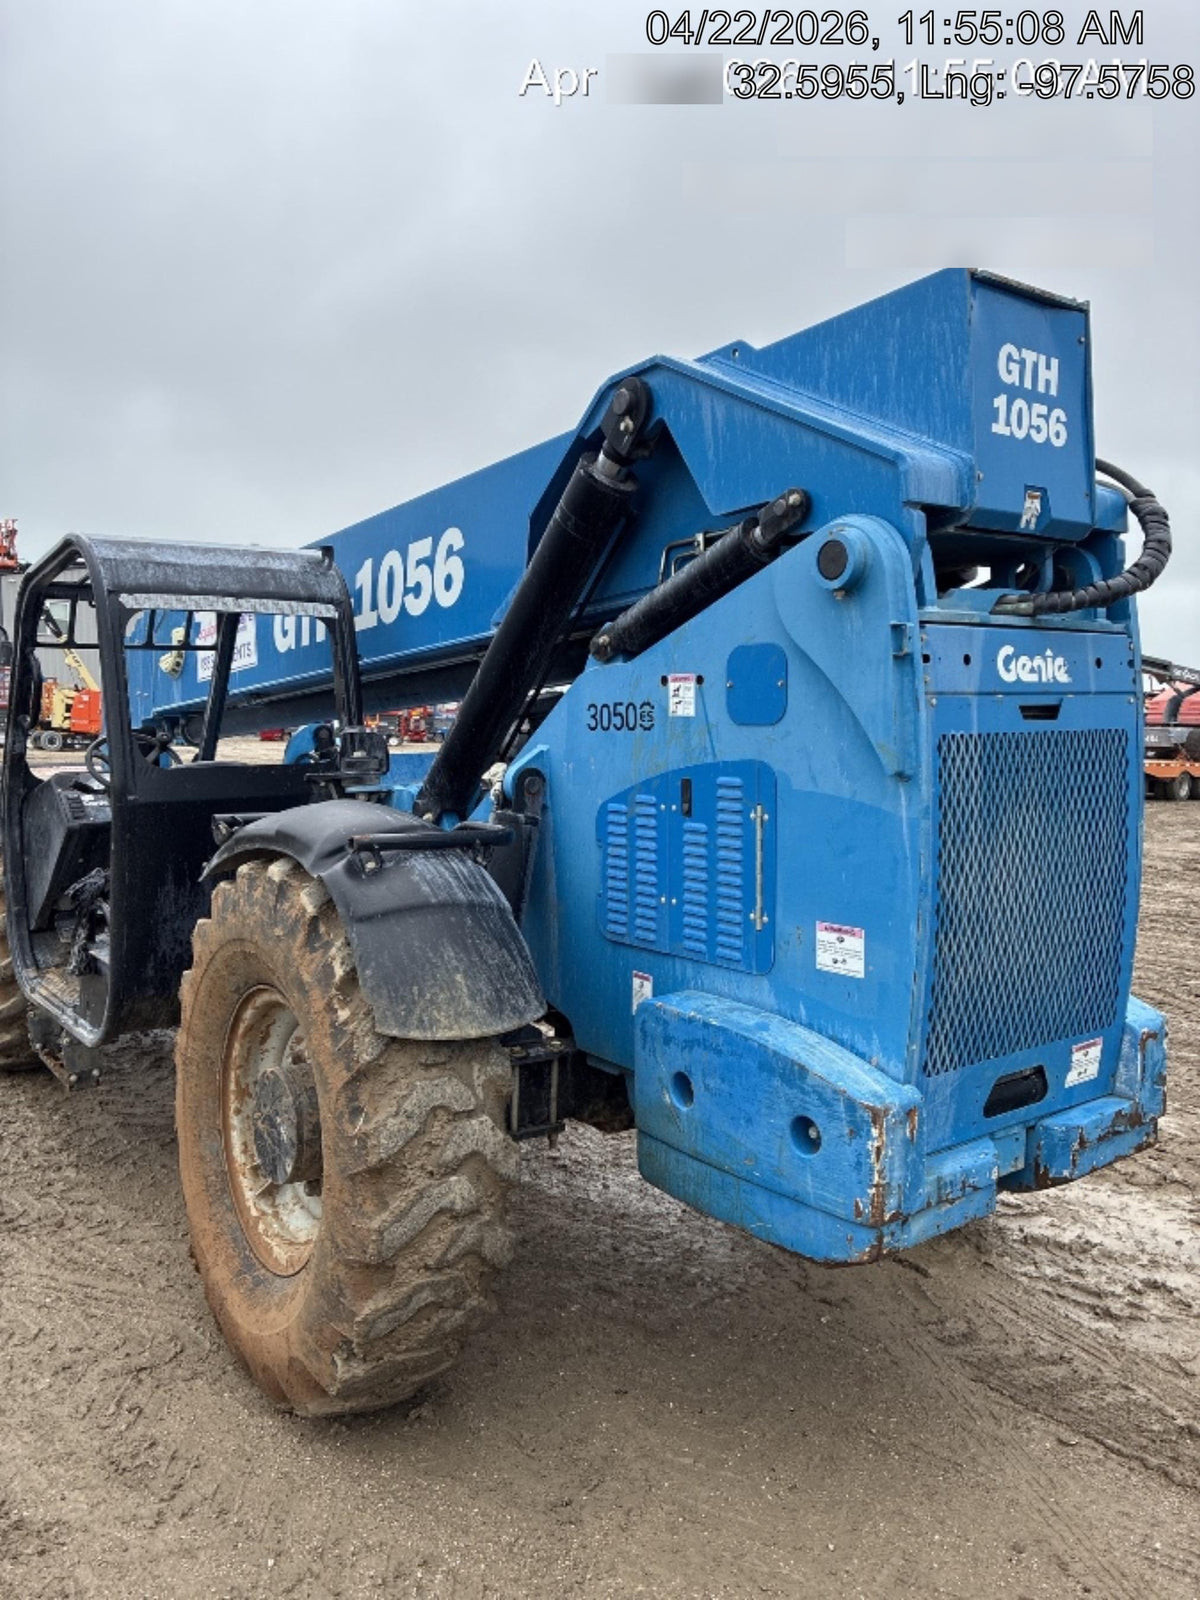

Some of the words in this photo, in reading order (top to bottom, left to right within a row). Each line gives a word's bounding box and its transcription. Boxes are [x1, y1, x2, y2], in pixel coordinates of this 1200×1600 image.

[998, 343, 1059, 397] GTH
[992, 394, 1068, 447] 1056
[997, 645, 1072, 683] Genie
